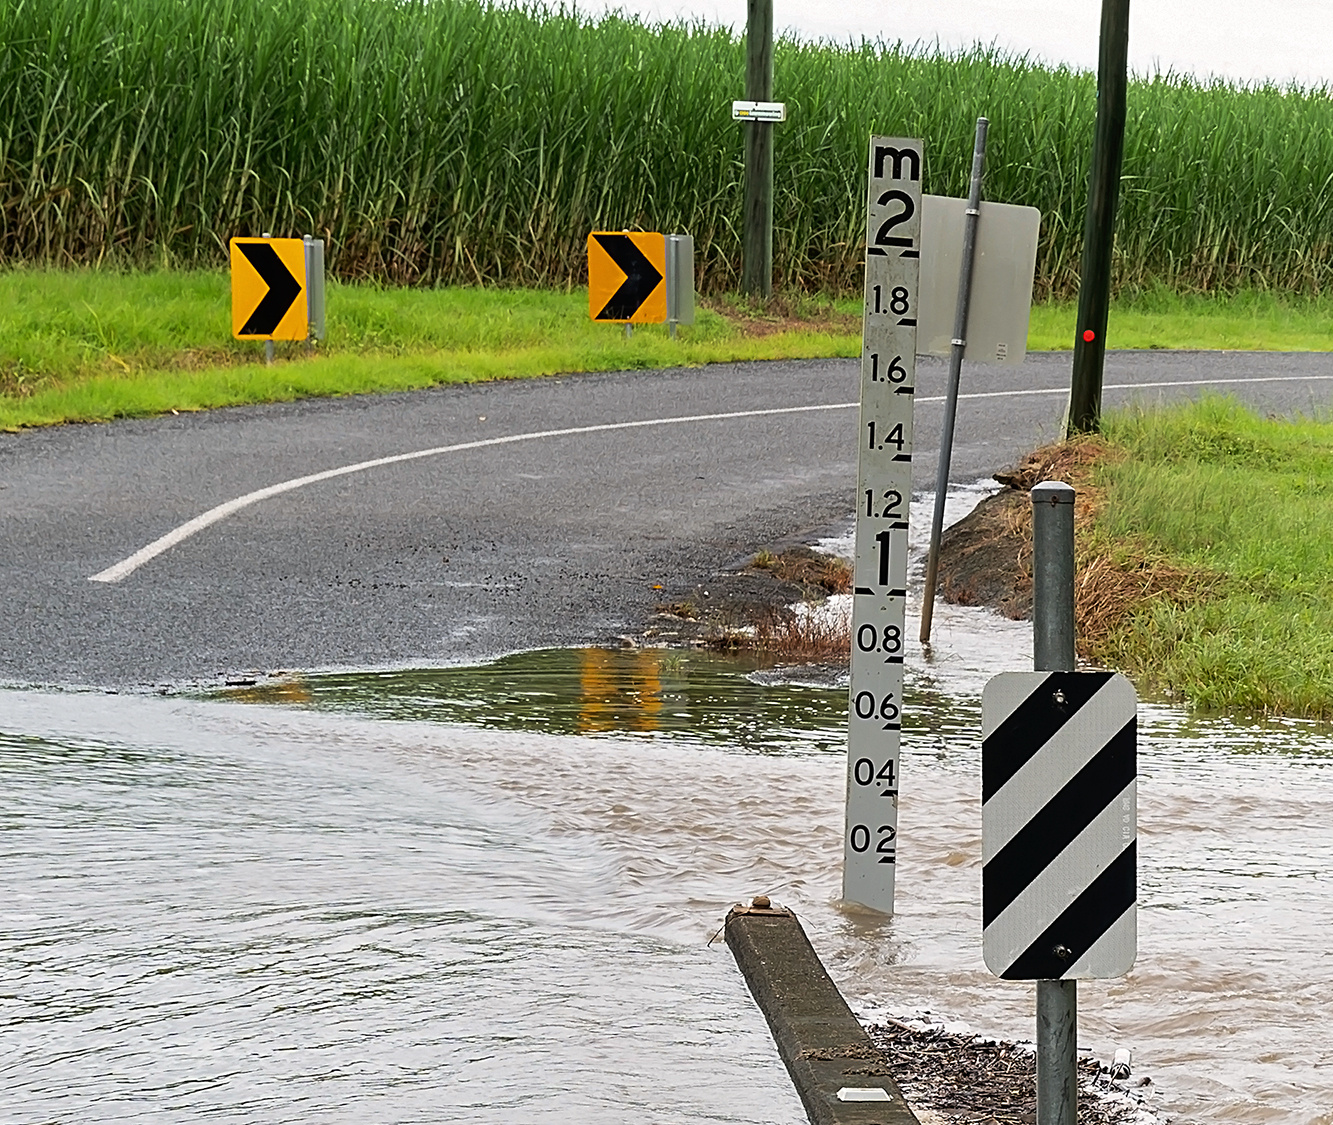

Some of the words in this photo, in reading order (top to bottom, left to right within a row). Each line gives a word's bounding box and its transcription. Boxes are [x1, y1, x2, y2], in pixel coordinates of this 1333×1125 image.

[873, 145, 921, 182] m
[874, 189, 915, 248] 2
[872, 284, 910, 316] 1.8
[870, 353, 907, 384] 1.6
[867, 421, 905, 452] 1.4
[864, 488, 903, 519] 1.2
[875, 530, 891, 587] 1
[856, 623, 902, 654] 0.8
[854, 690, 899, 721] 0.6
[854, 757, 896, 787] 0.4
